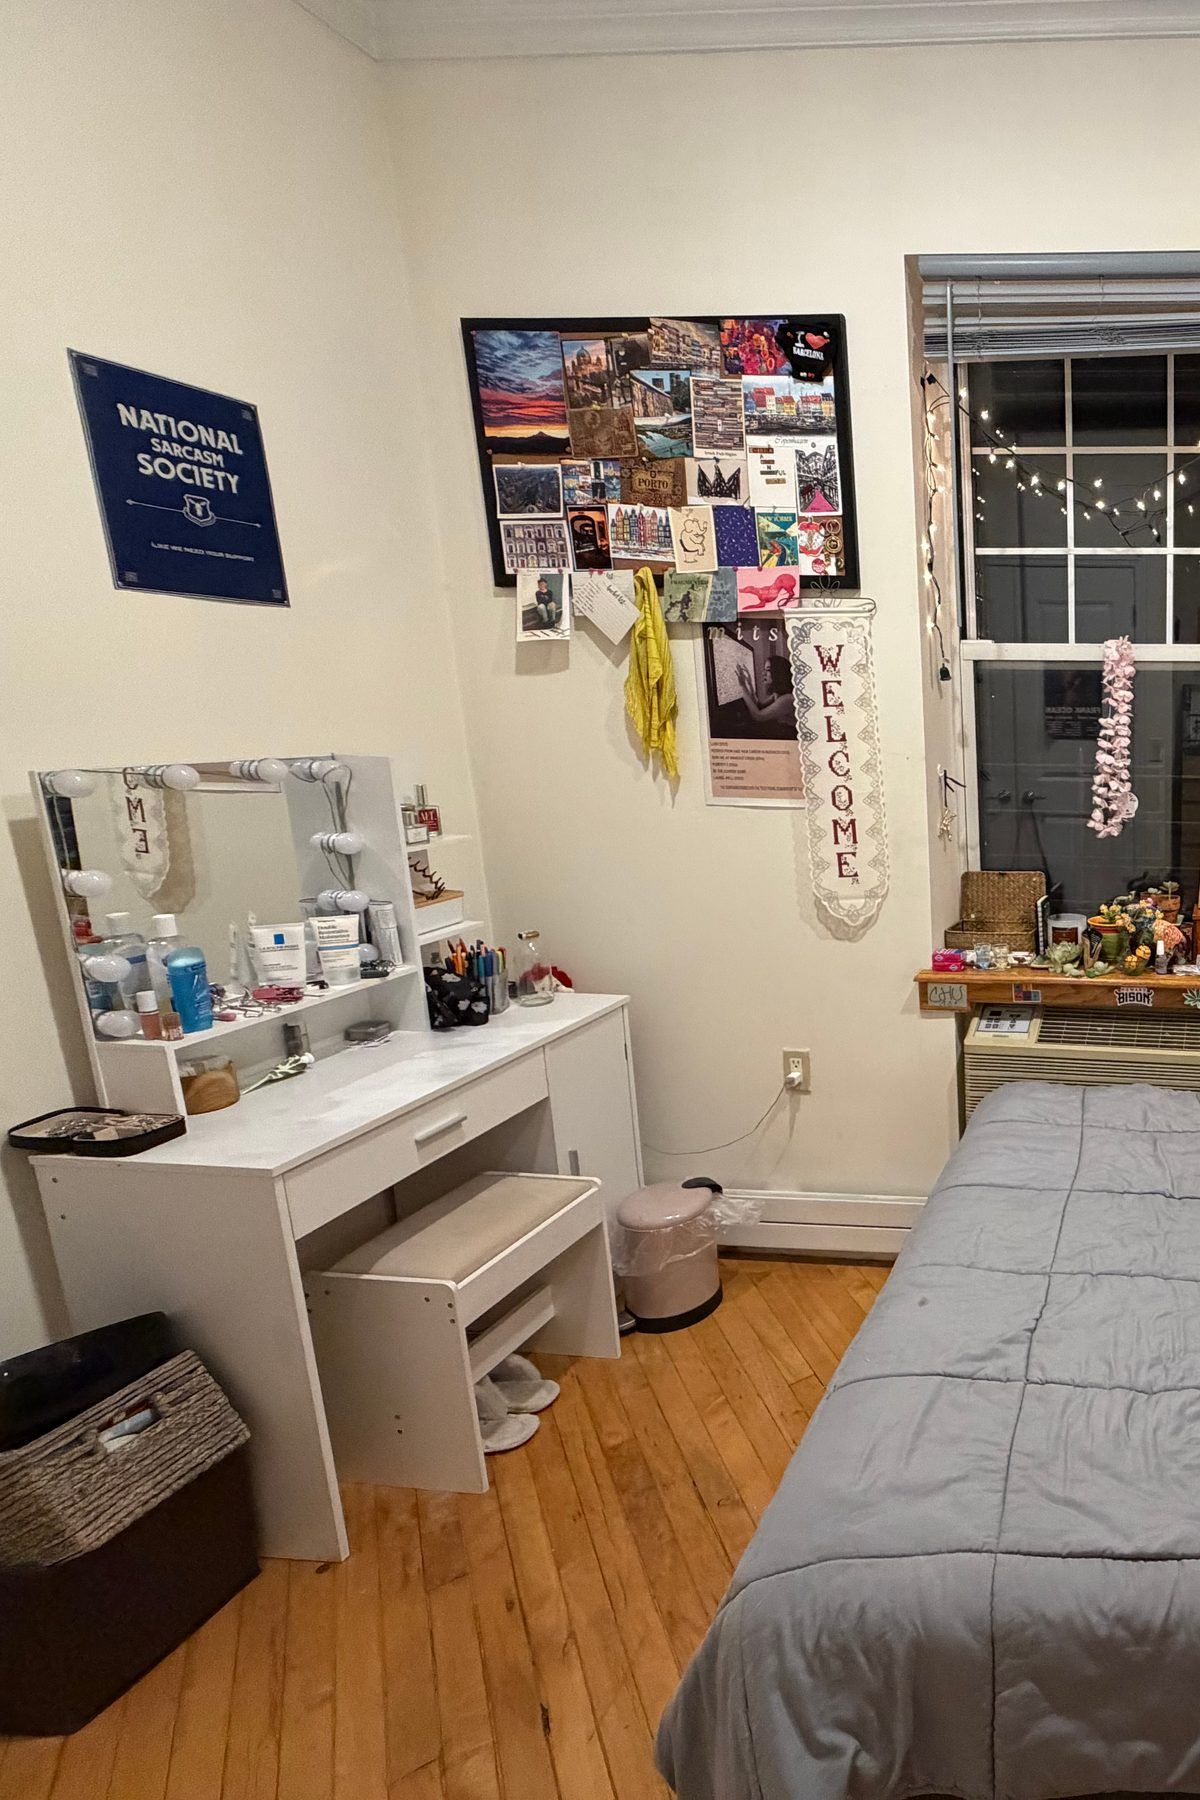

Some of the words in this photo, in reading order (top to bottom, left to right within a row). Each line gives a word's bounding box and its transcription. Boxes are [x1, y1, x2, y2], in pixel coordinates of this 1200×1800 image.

[795, 331, 805, 348] I
[792, 346, 824, 360] BARCELONA
[116, 402, 244, 455] NATIONAL
[150, 437, 225, 468] SARCASM
[136, 453, 240, 494] SOCIETY
[638, 478, 669, 489] PORTO
[707, 622, 779, 641] mits
[813, 644, 860, 880] WELCOME
[1115, 990, 1154, 1005] BISON
